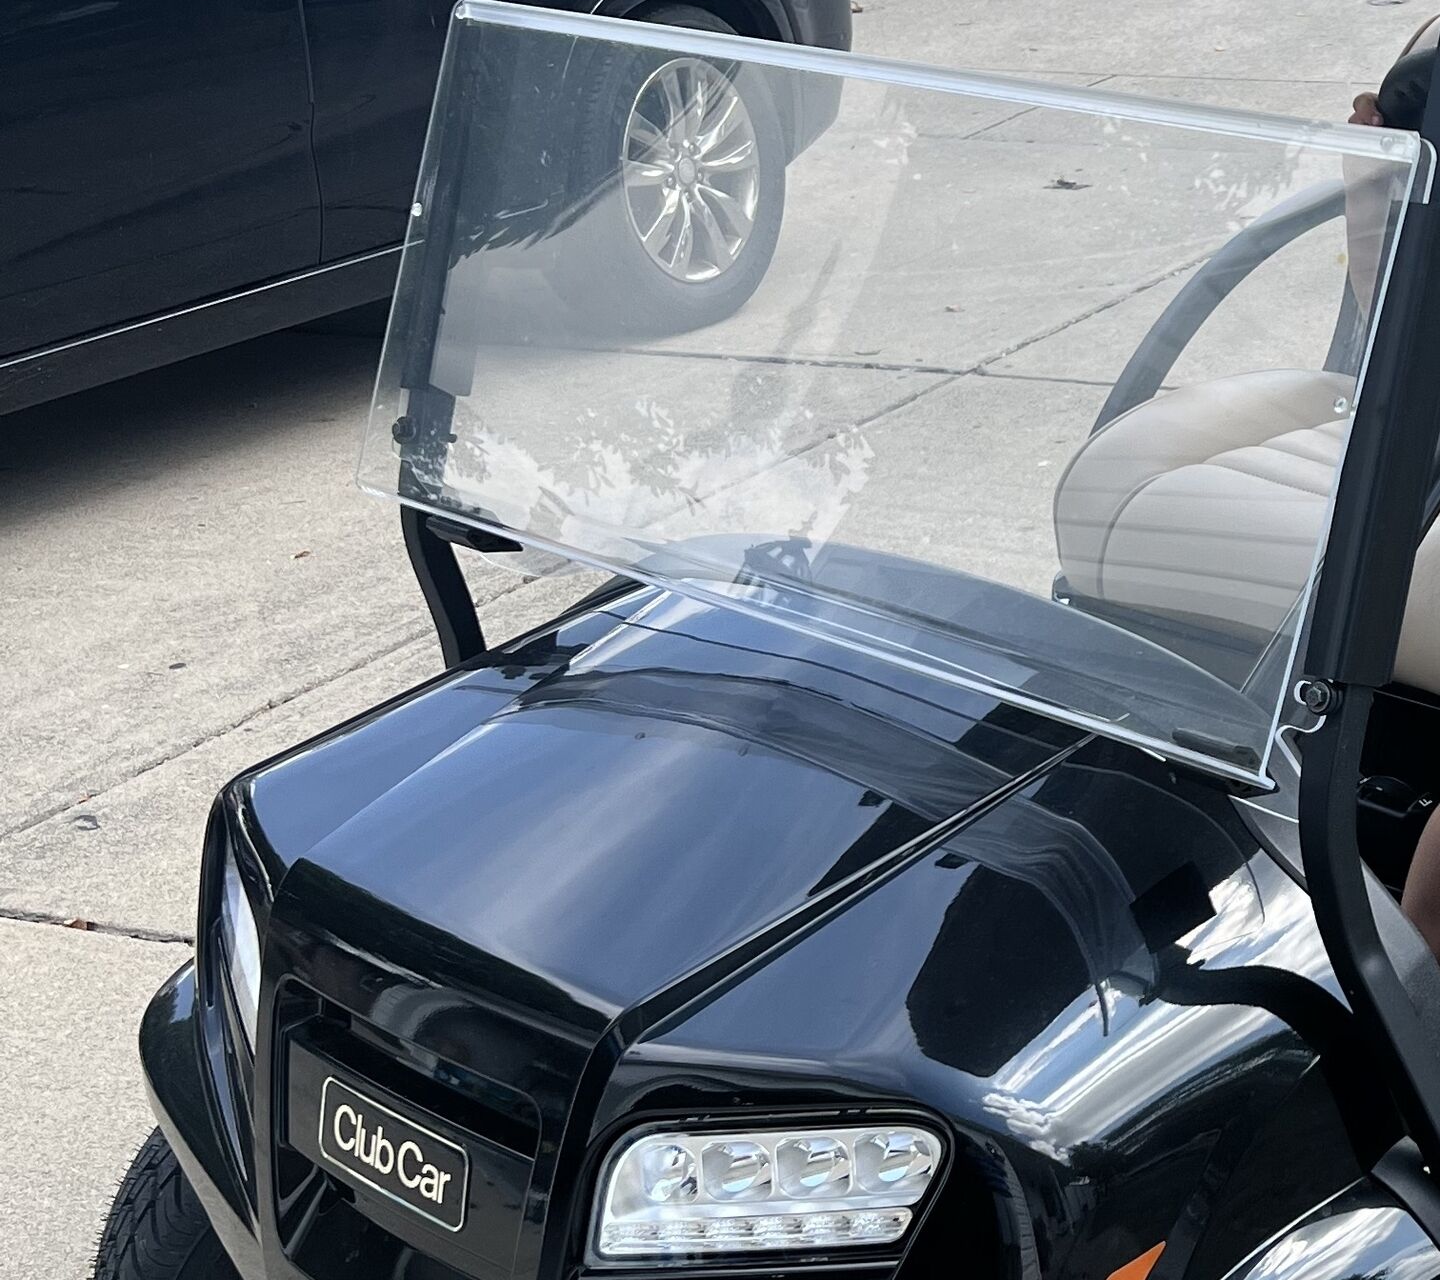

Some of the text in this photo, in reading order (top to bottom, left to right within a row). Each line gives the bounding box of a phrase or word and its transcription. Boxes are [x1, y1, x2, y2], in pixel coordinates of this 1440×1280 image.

[1417, 797, 1433, 808] F
[333, 1104, 451, 1205] Club Car
